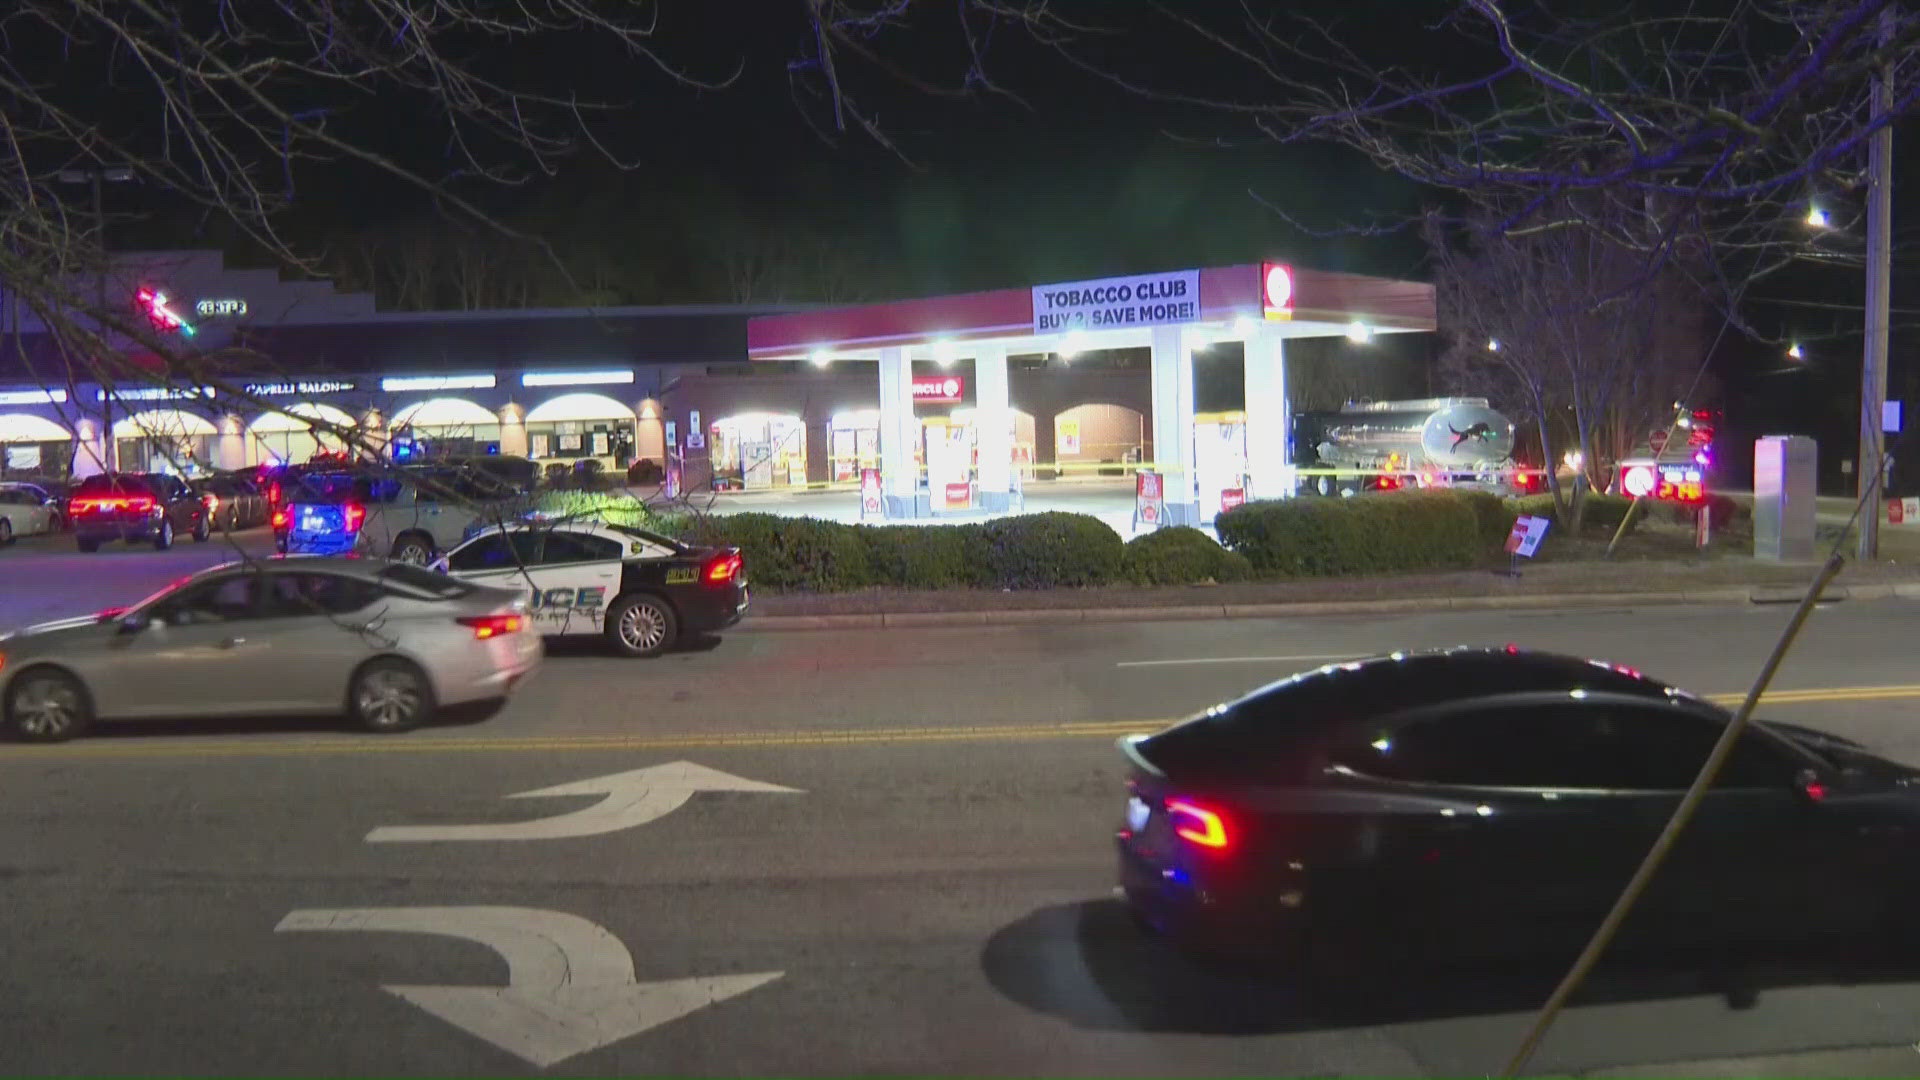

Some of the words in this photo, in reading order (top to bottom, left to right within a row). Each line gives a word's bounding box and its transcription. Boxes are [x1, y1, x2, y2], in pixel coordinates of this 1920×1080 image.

[1044, 285, 1132, 309] TOBACCO
[1136, 279, 1187, 301] CLUB
[196, 299, 247, 314] CENTER
[1039, 312, 1071, 330] BUY
[1092, 307, 1136, 325] SAVE
[1139, 302, 1194, 322] MORE!
[245, 383, 296, 397] CAPELLI
[298, 381, 340, 394] SALON
[531, 586, 607, 609] ICE
